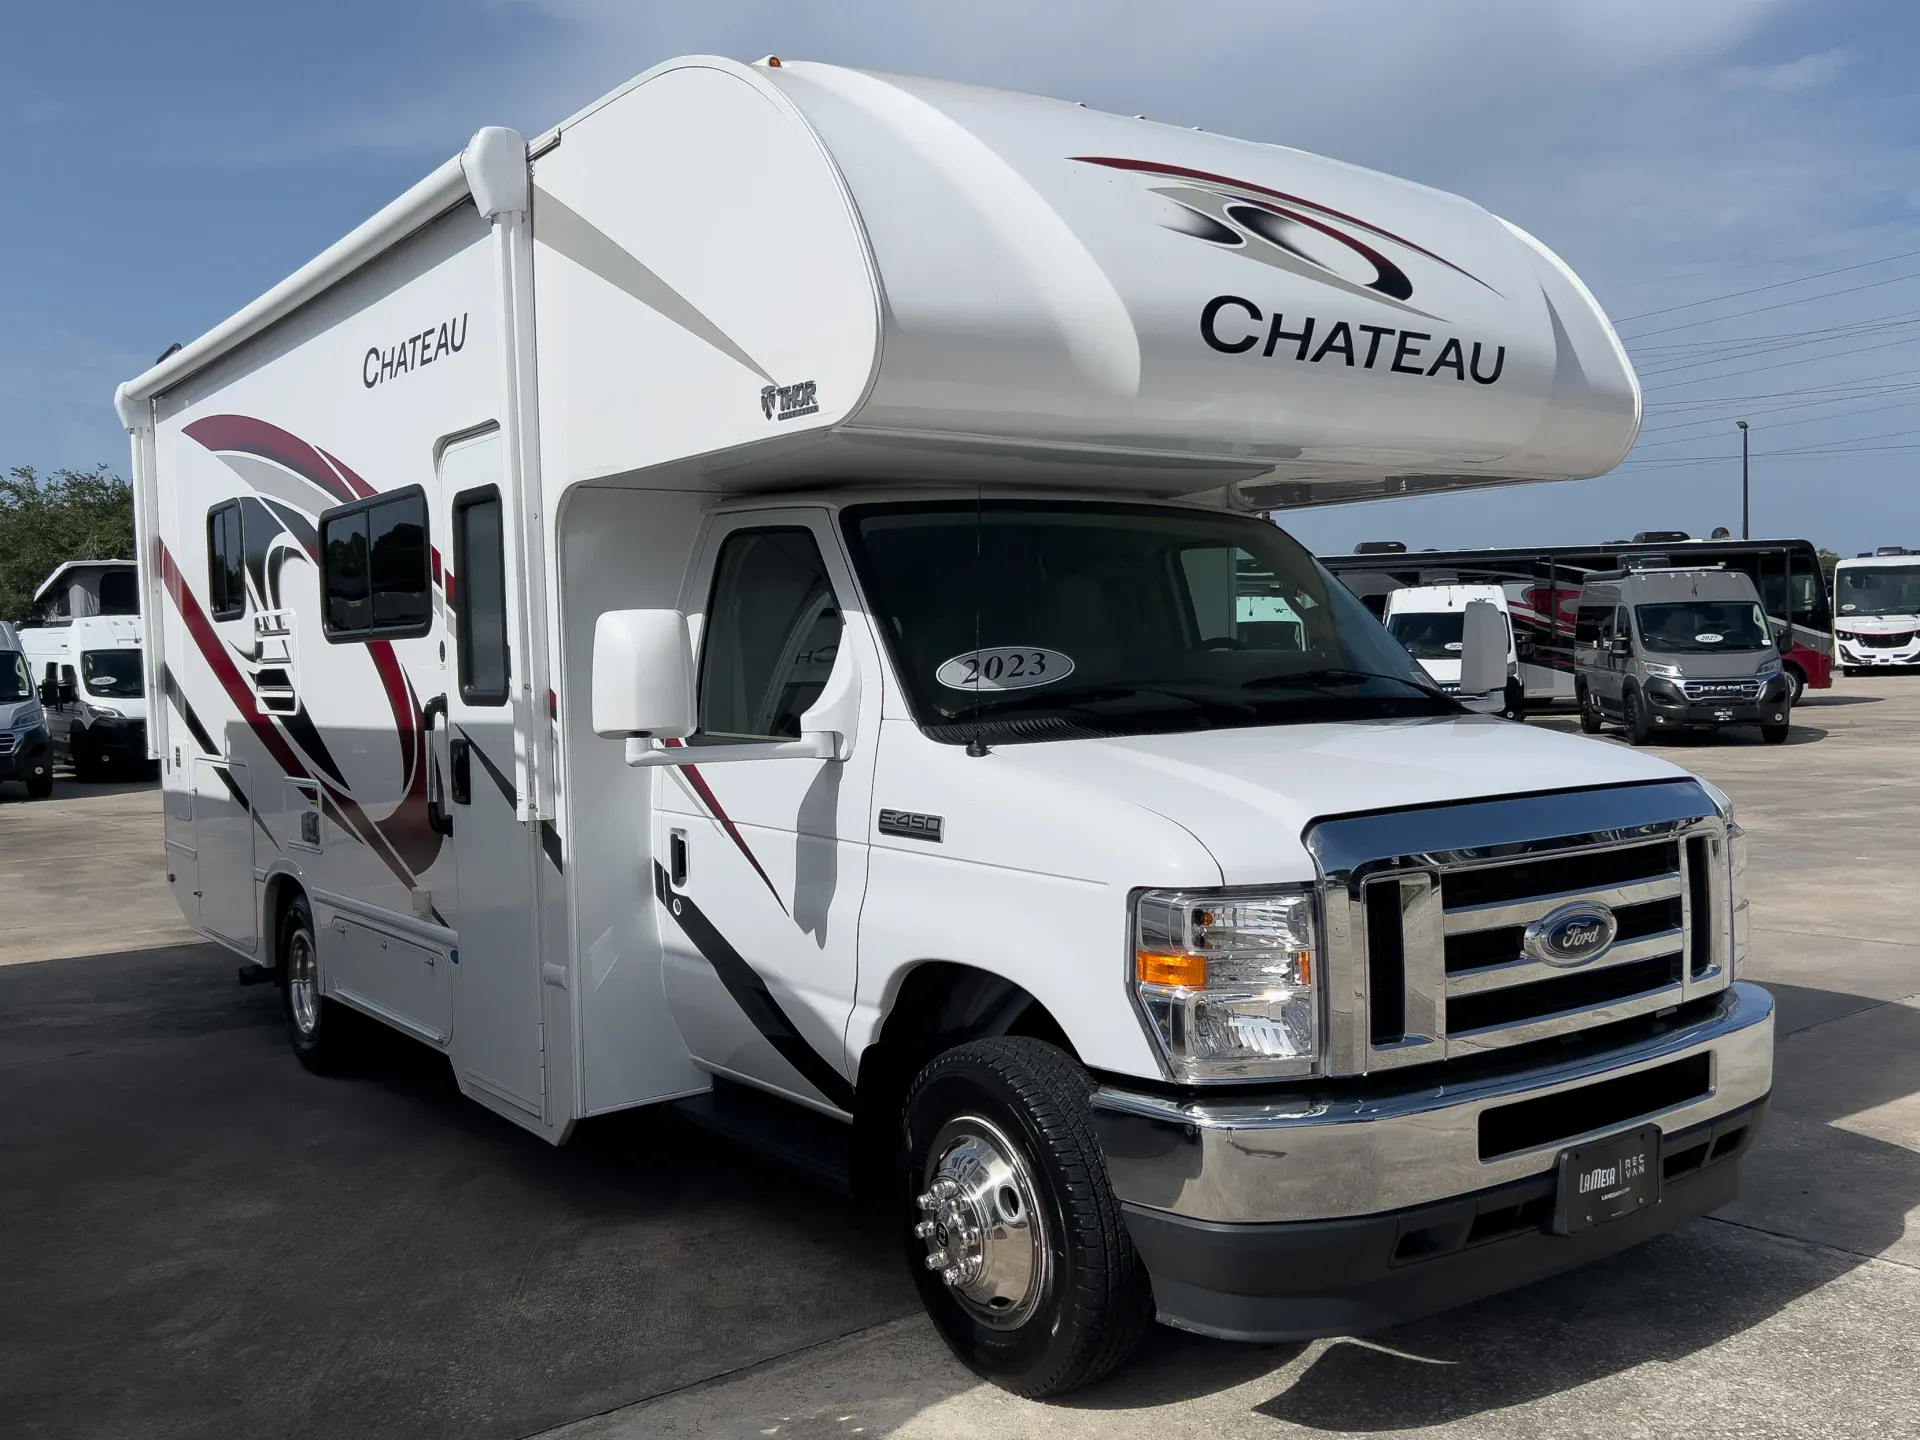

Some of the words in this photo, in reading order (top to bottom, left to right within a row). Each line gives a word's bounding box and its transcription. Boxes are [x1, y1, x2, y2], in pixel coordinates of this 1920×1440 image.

[363, 312, 468, 389] CHATEAU
[1200, 295, 1506, 386] CHATEAU
[777, 380, 818, 411] THOR
[961, 652, 1046, 684] 2023
[1562, 921, 1599, 948] Ford
[1624, 1154, 1645, 1169] REC
[1625, 1163, 1645, 1178] VAN
